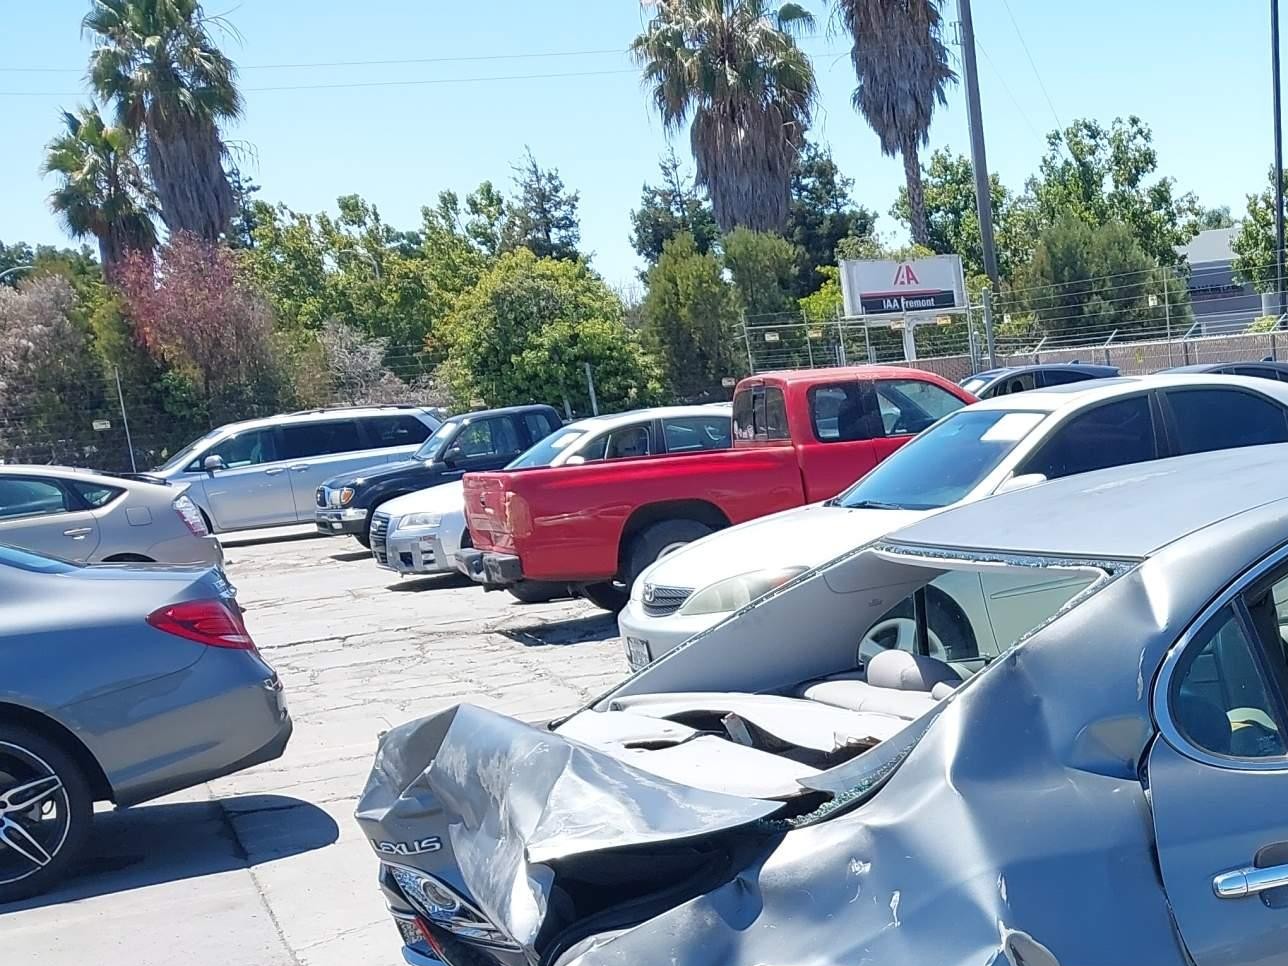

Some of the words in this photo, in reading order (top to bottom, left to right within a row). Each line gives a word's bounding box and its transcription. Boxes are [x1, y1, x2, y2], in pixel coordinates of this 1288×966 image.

[882, 298, 900, 310] IAA
[901, 296, 936, 309] Fremont
[370, 837, 442, 856] LEXUS
